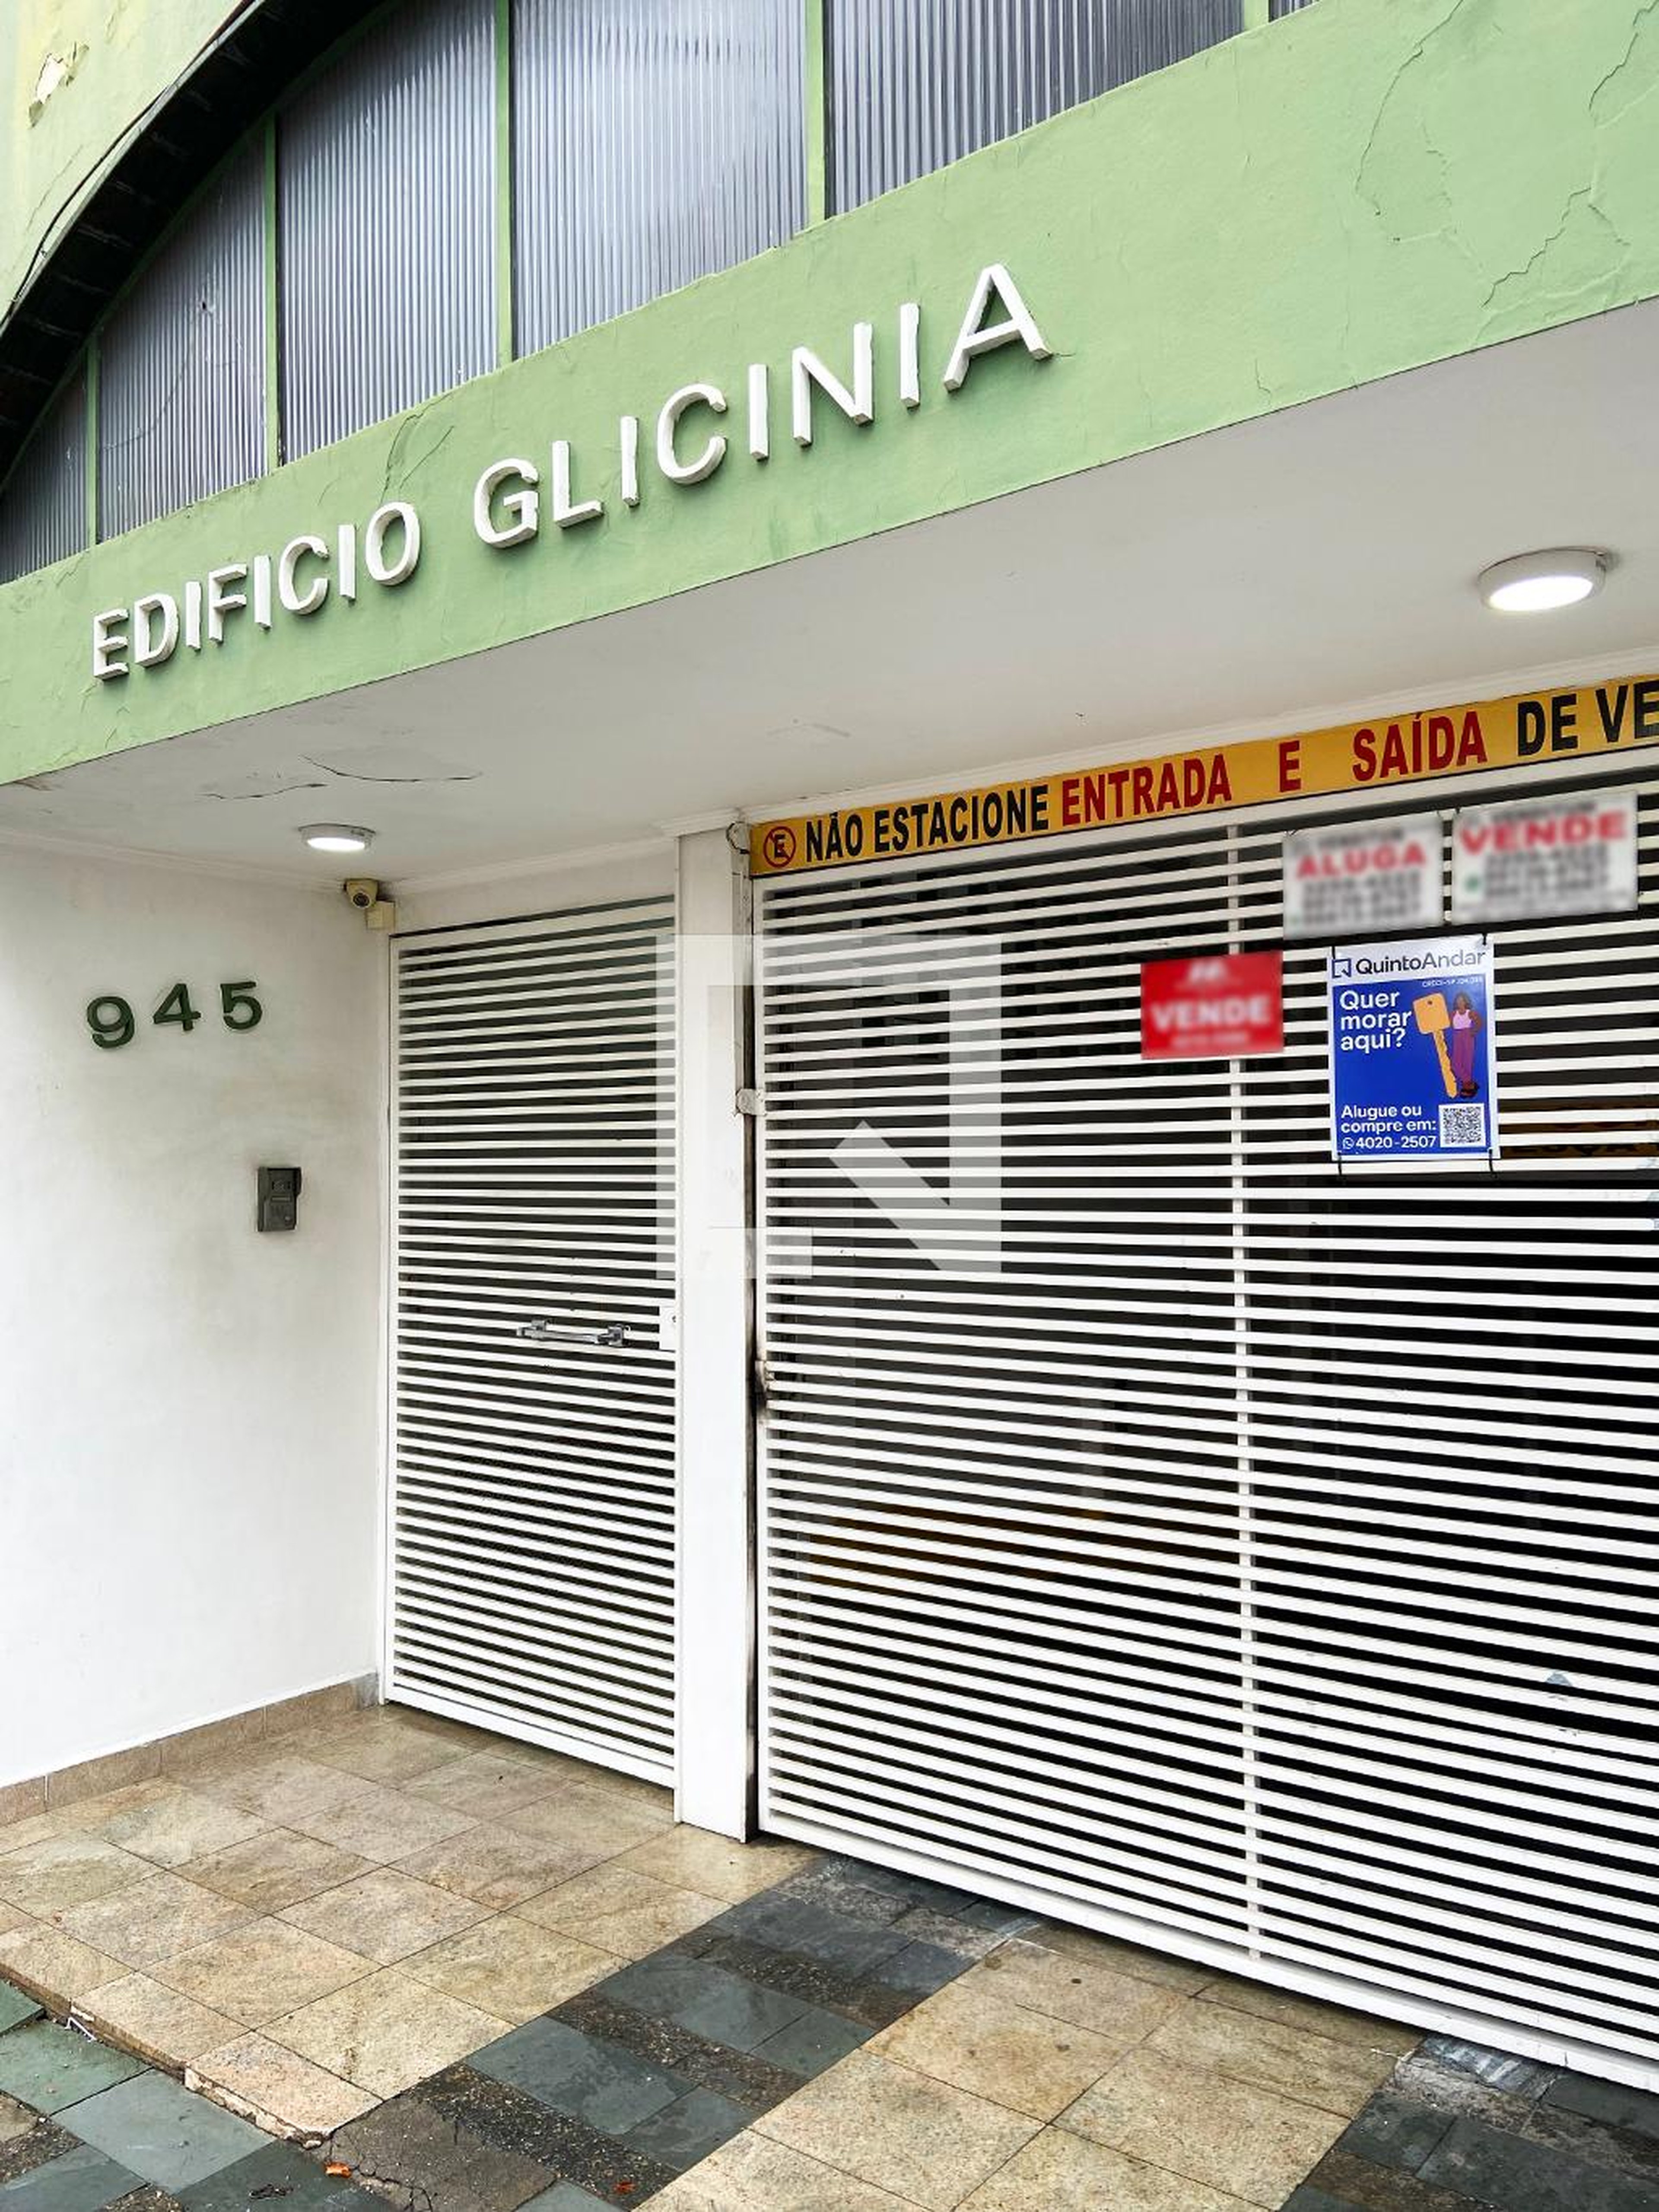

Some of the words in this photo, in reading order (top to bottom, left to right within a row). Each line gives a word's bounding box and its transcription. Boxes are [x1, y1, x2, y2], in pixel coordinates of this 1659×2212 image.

[93, 501, 421, 681] EDIFICIO
[473, 263, 1052, 549] GLICINIA
[806, 812, 863, 862] NÃO
[874, 784, 1049, 853] ESTACIONE
[1061, 753, 1232, 826] ENTRADA
[1279, 741, 1302, 793] E
[1352, 712, 1488, 781] SAÍDA
[1517, 693, 1578, 757] DE
[1595, 680, 1659, 743] VE
[1459, 812, 1625, 856] VENDE
[1297, 842, 1426, 878] ALUGA
[1356, 949, 1485, 975] QuintoAndar
[87, 981, 262, 1048] 945
[1150, 995, 1271, 1032] VENDE
[1340, 991, 1400, 1010] Quer
[1341, 1011, 1412, 1030] morar
[1341, 1028, 1406, 1053] aqui?
[1341, 1105, 1398, 1120] Alugue
[1401, 1106, 1422, 1116] ou
[1341, 1122, 1403, 1135] compre
[1406, 1120, 1437, 1131] em:
